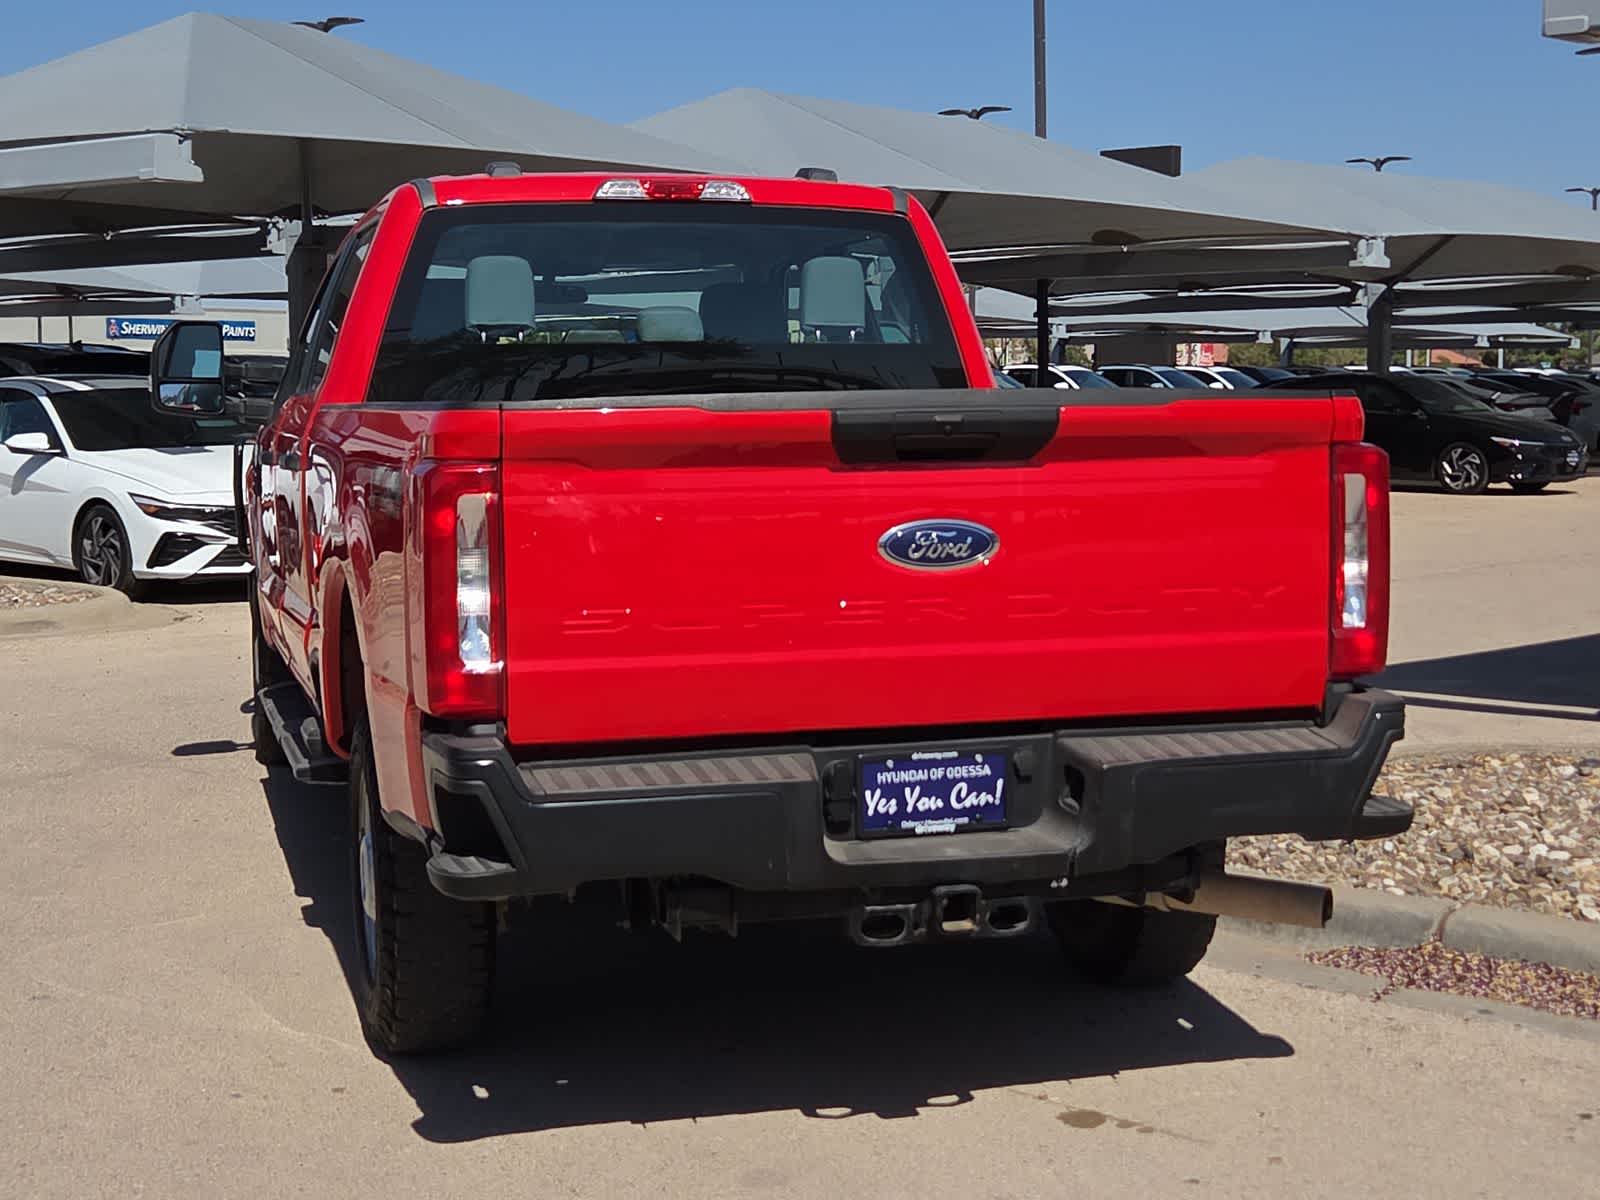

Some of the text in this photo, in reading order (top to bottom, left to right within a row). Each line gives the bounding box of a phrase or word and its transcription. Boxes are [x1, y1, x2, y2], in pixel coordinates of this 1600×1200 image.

[222, 324, 256, 337] PAINTS
[907, 530, 973, 559] Ford
[877, 764, 992, 785] HYUNDAI OF ODESSA
[864, 778, 1004, 817] Yes You Can!
